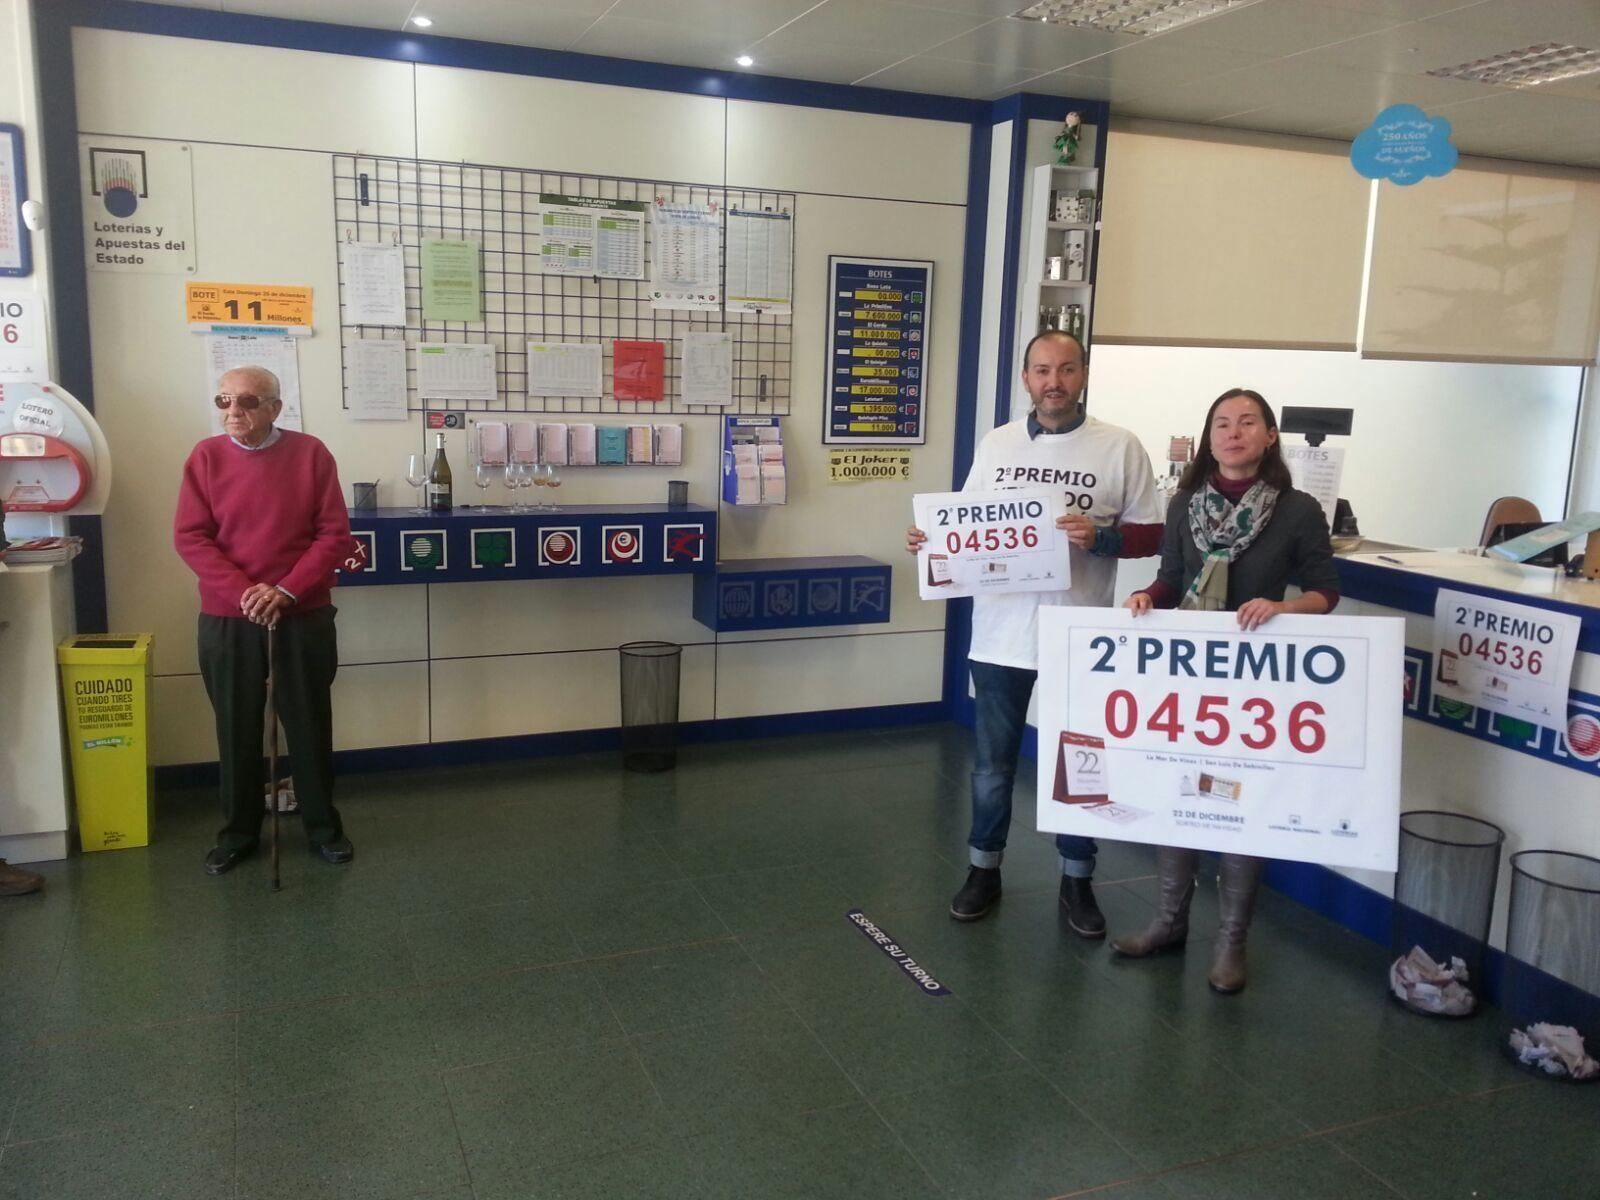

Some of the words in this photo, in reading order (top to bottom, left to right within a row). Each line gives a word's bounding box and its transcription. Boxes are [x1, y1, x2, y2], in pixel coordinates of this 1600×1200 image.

[155, 225, 163, 236] y
[95, 238, 160, 251] Apuestas
[165, 241, 185, 251] del
[96, 253, 144, 265] Estado
[868, 270, 892, 278] BOTES
[192, 291, 216, 299] BOTE
[267, 314, 302, 323] Millones
[22, 403, 53, 416] LOTERO
[19, 415, 51, 428] OFICIAL
[1288, 449, 1328, 461] BOTES
[831, 466, 896, 477] 1.000.000
[901, 466, 909, 476] €
[1014, 467, 1097, 488] PREMIO
[957, 500, 1043, 525] PREMIO
[947, 525, 1039, 554] 04536
[1474, 610, 1554, 644] PREMIO
[1459, 633, 1543, 675] 04536
[1137, 637, 1346, 685] PREMIO
[75, 678, 132, 695] CUIDADO
[76, 695, 109, 705] CUANDO
[111, 694, 133, 703] TIRES
[80, 712, 133, 723] EUROMILLONES
[1105, 689, 1326, 754] 04536
[1075, 750, 1101, 774] 22
[1173, 809, 1183, 817] 22
[1185, 810, 1196, 818] DE
[1199, 812, 1245, 824] DICIEMBRE
[849, 912, 892, 945] ESPERE
[884, 944, 906, 957] SU
[900, 957, 940, 990] TURNO
